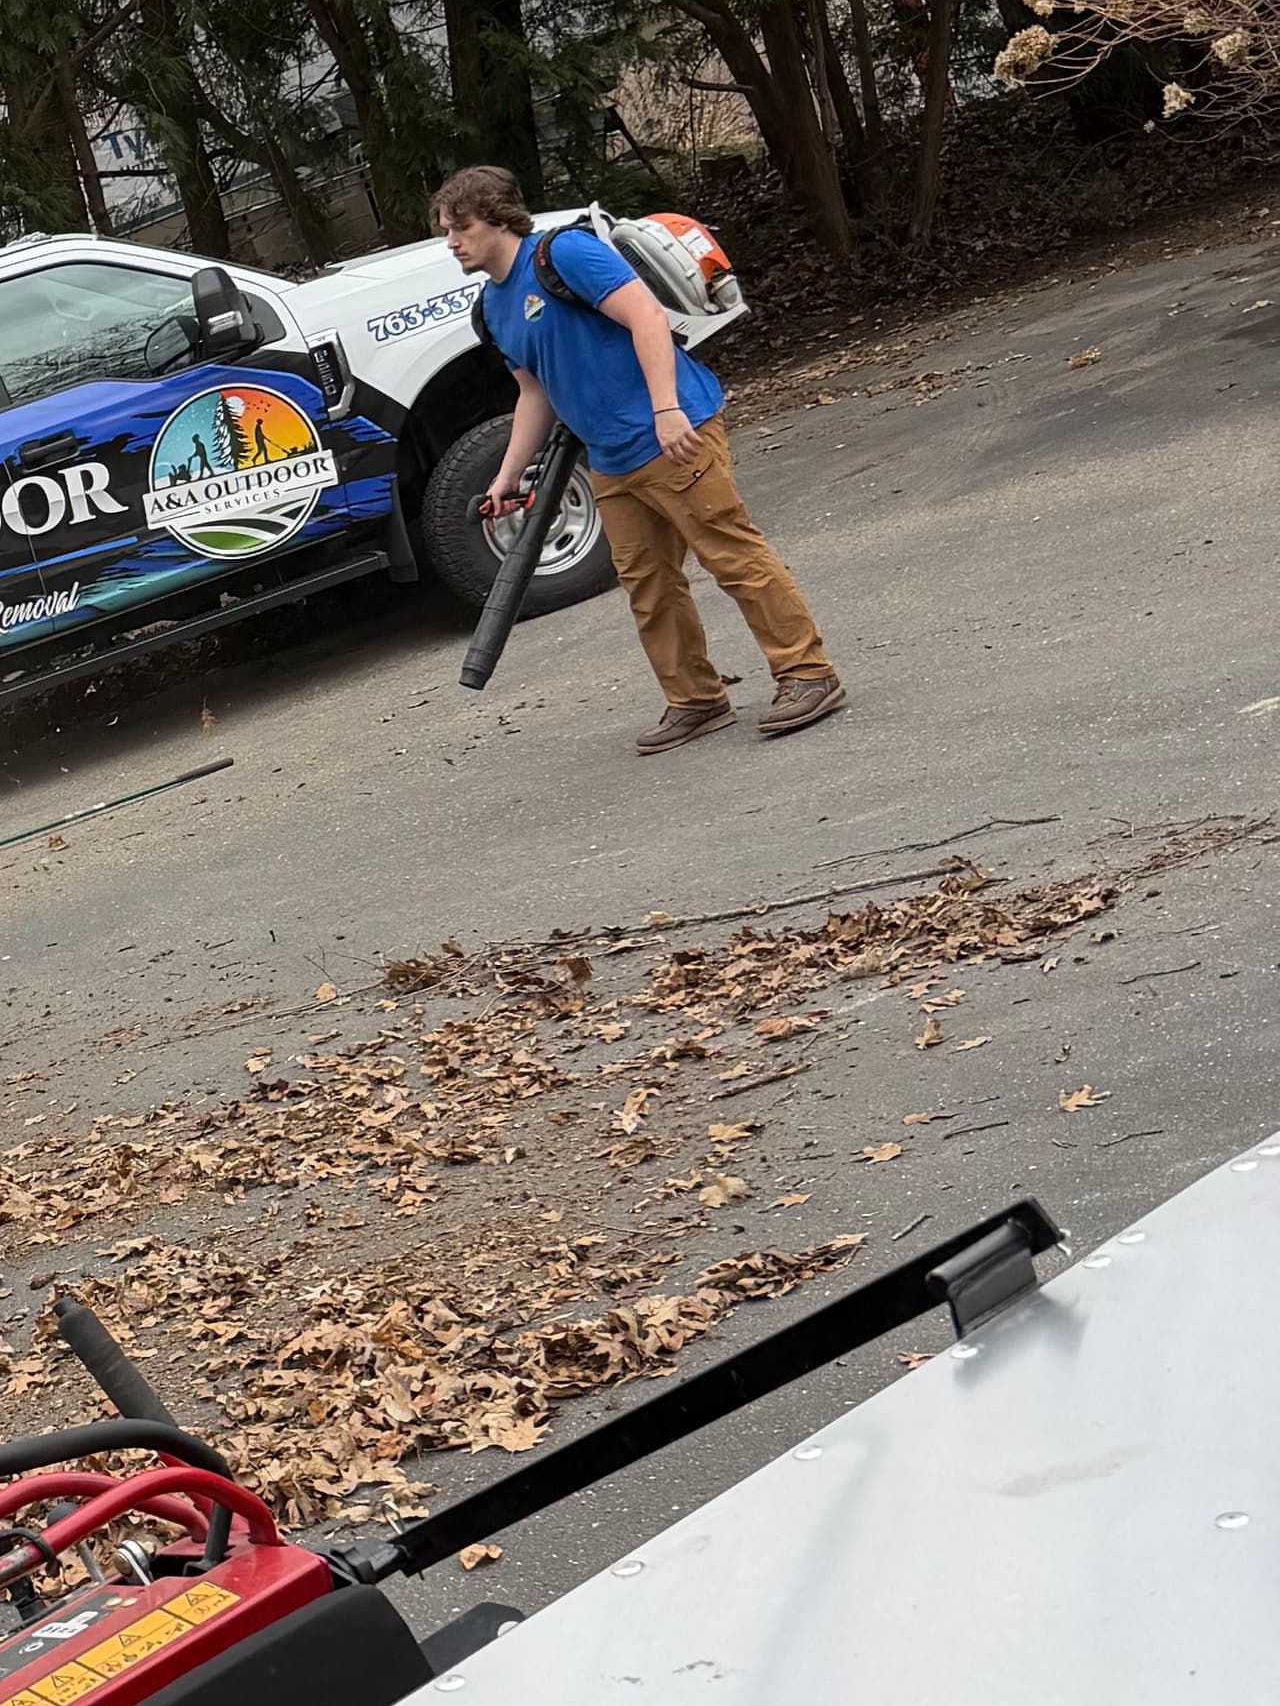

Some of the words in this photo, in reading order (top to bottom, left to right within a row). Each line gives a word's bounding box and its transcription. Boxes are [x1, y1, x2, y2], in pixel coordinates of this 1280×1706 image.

[149, 486, 200, 516] A&A
[204, 456, 331, 502] OUTDOOR
[205, 487, 281, 515] SERVICES
